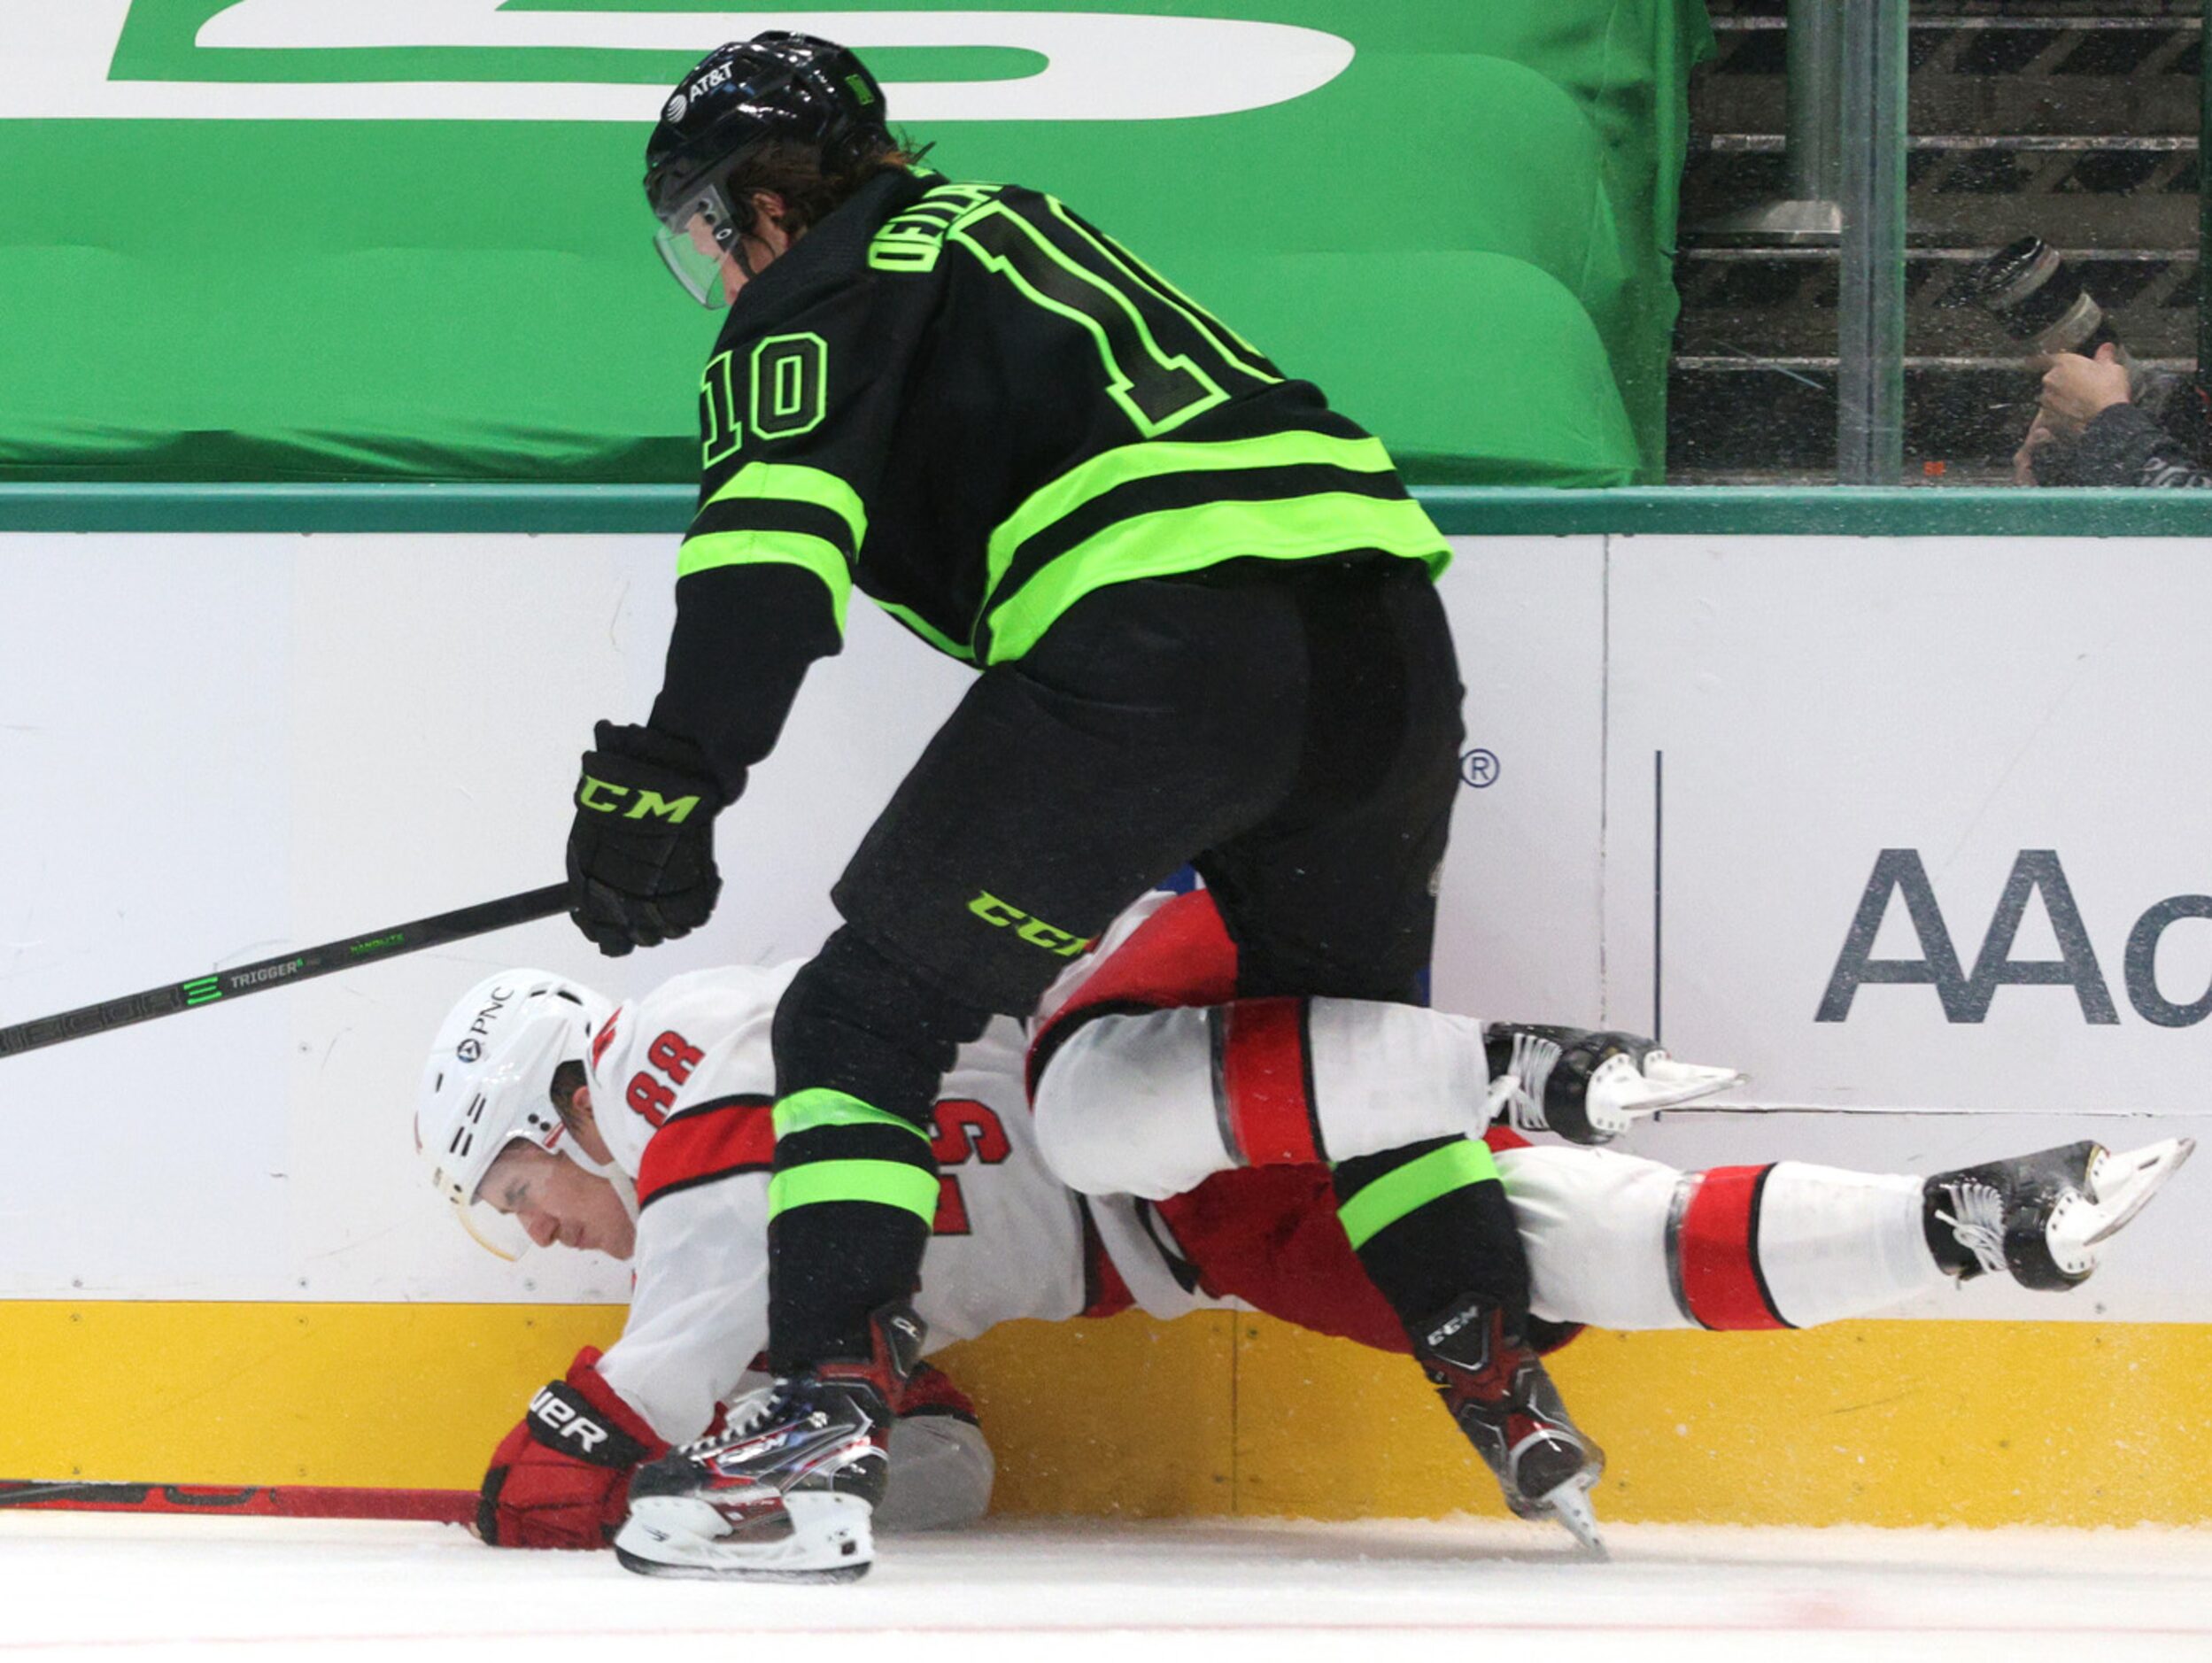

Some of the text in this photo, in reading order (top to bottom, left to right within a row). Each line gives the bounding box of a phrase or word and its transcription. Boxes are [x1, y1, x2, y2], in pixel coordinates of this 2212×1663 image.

[690, 61, 734, 104] AT&T
[945, 194, 1287, 439] 10
[700, 331, 829, 471] 10
[470, 986, 515, 1036] PNC
[626, 1031, 707, 1130] 88
[1427, 1305, 1479, 1345] CCM
